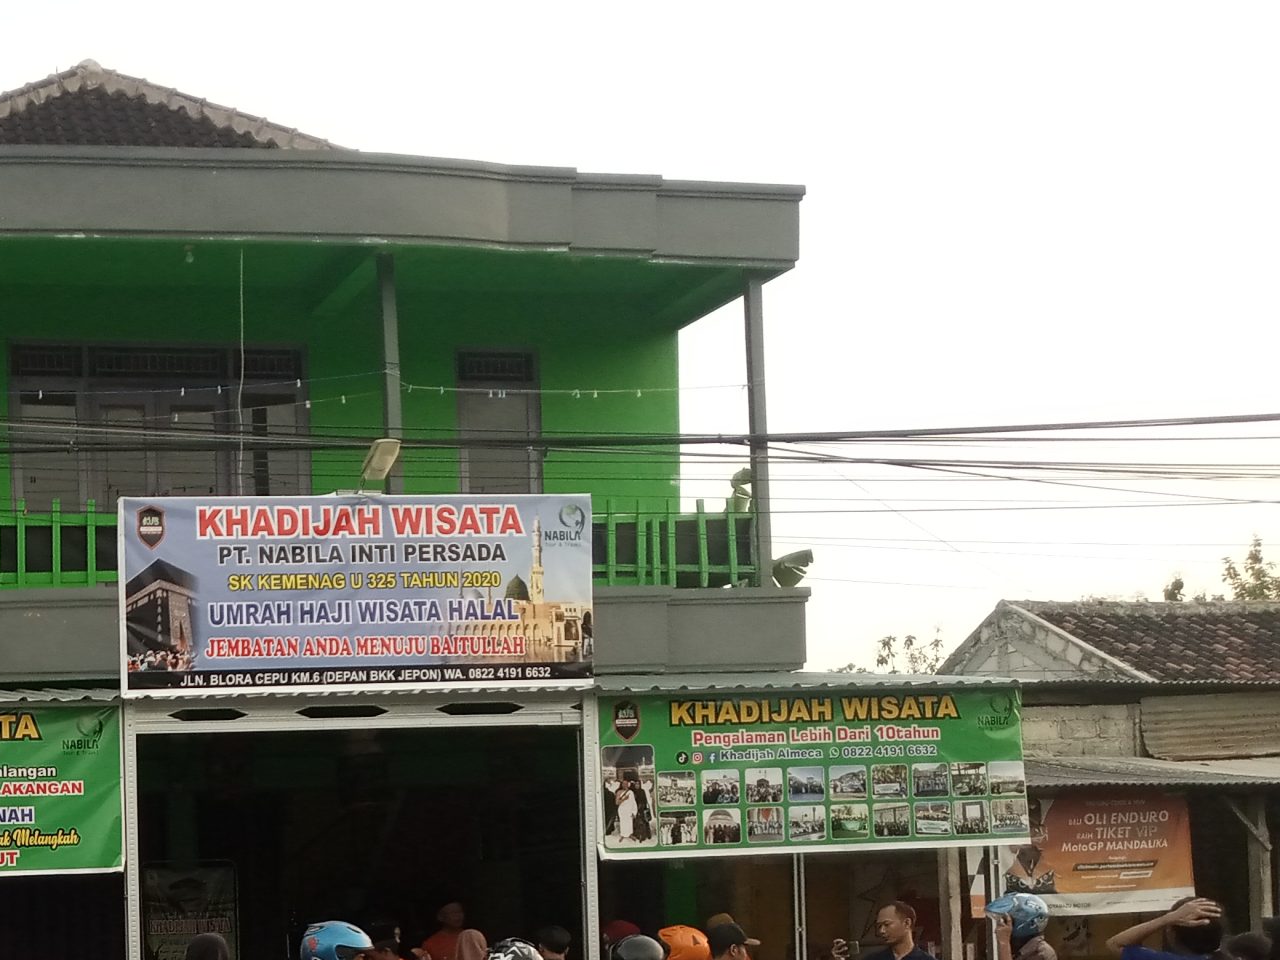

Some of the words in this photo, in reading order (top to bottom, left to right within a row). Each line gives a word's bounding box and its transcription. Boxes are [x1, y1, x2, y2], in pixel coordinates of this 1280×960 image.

[197, 505, 382, 539] KHADIJAH
[390, 505, 524, 537] WISATA
[544, 530, 580, 541] NABILA
[219, 545, 251, 565] PT.
[259, 544, 343, 564] NABILA
[351, 543, 396, 563] INTI
[404, 543, 507, 562] PERSADA
[228, 574, 253, 591] SK
[257, 573, 346, 591] KEMENAG
[350, 572, 363, 589] U
[367, 572, 397, 589] 325
[401, 572, 459, 588] TAHUN
[463, 571, 501, 587] 2020
[208, 601, 292, 626] UMRAH
[299, 600, 352, 625] HAJI
[357, 599, 442, 623] WISATA
[448, 598, 521, 621] HALAL
[205, 636, 299, 659] JEMBATAN
[303, 636, 353, 657] ANDA
[355, 635, 426, 656] MENUJU
[430, 635, 526, 656] BAITULLAH
[180, 674, 207, 687] JLN.
[210, 673, 252, 686] BLORA
[255, 672, 288, 685] CEPU
[291, 672, 320, 684] KM.6
[322, 670, 367, 685] (DEPAN
[370, 669, 396, 682] BKK
[398, 668, 442, 682] JEPON)
[444, 668, 466, 680] WA.
[469, 668, 495, 679] 0822
[497, 667, 522, 679] 4191
[525, 666, 551, 678] 6632
[671, 698, 833, 726] KHADIJAH
[842, 695, 960, 721] WISATA
[977, 716, 1008, 726] NABILA
[63, 739, 99, 749] NABILA
[692, 730, 787, 748] Pengalaman
[790, 727, 833, 743] Lebih
[836, 726, 871, 742] Dari
[874, 725, 941, 740] 10tahun
[721, 750, 774, 762] Khadijah
[777, 748, 823, 759] Almeca
[842, 747, 872, 758] 0822
[875, 746, 904, 757] 4191
[907, 745, 937, 756] 6632
[1084, 812, 1107, 825] OLI
[1110, 810, 1169, 825] ENDURO
[12, 828, 80, 849] Melangkah
[1095, 826, 1131, 839] TIKET
[1135, 825, 1158, 838] VIP
[1061, 841, 1104, 852] MotoGP
[1105, 838, 1169, 851] MANDALIKA
